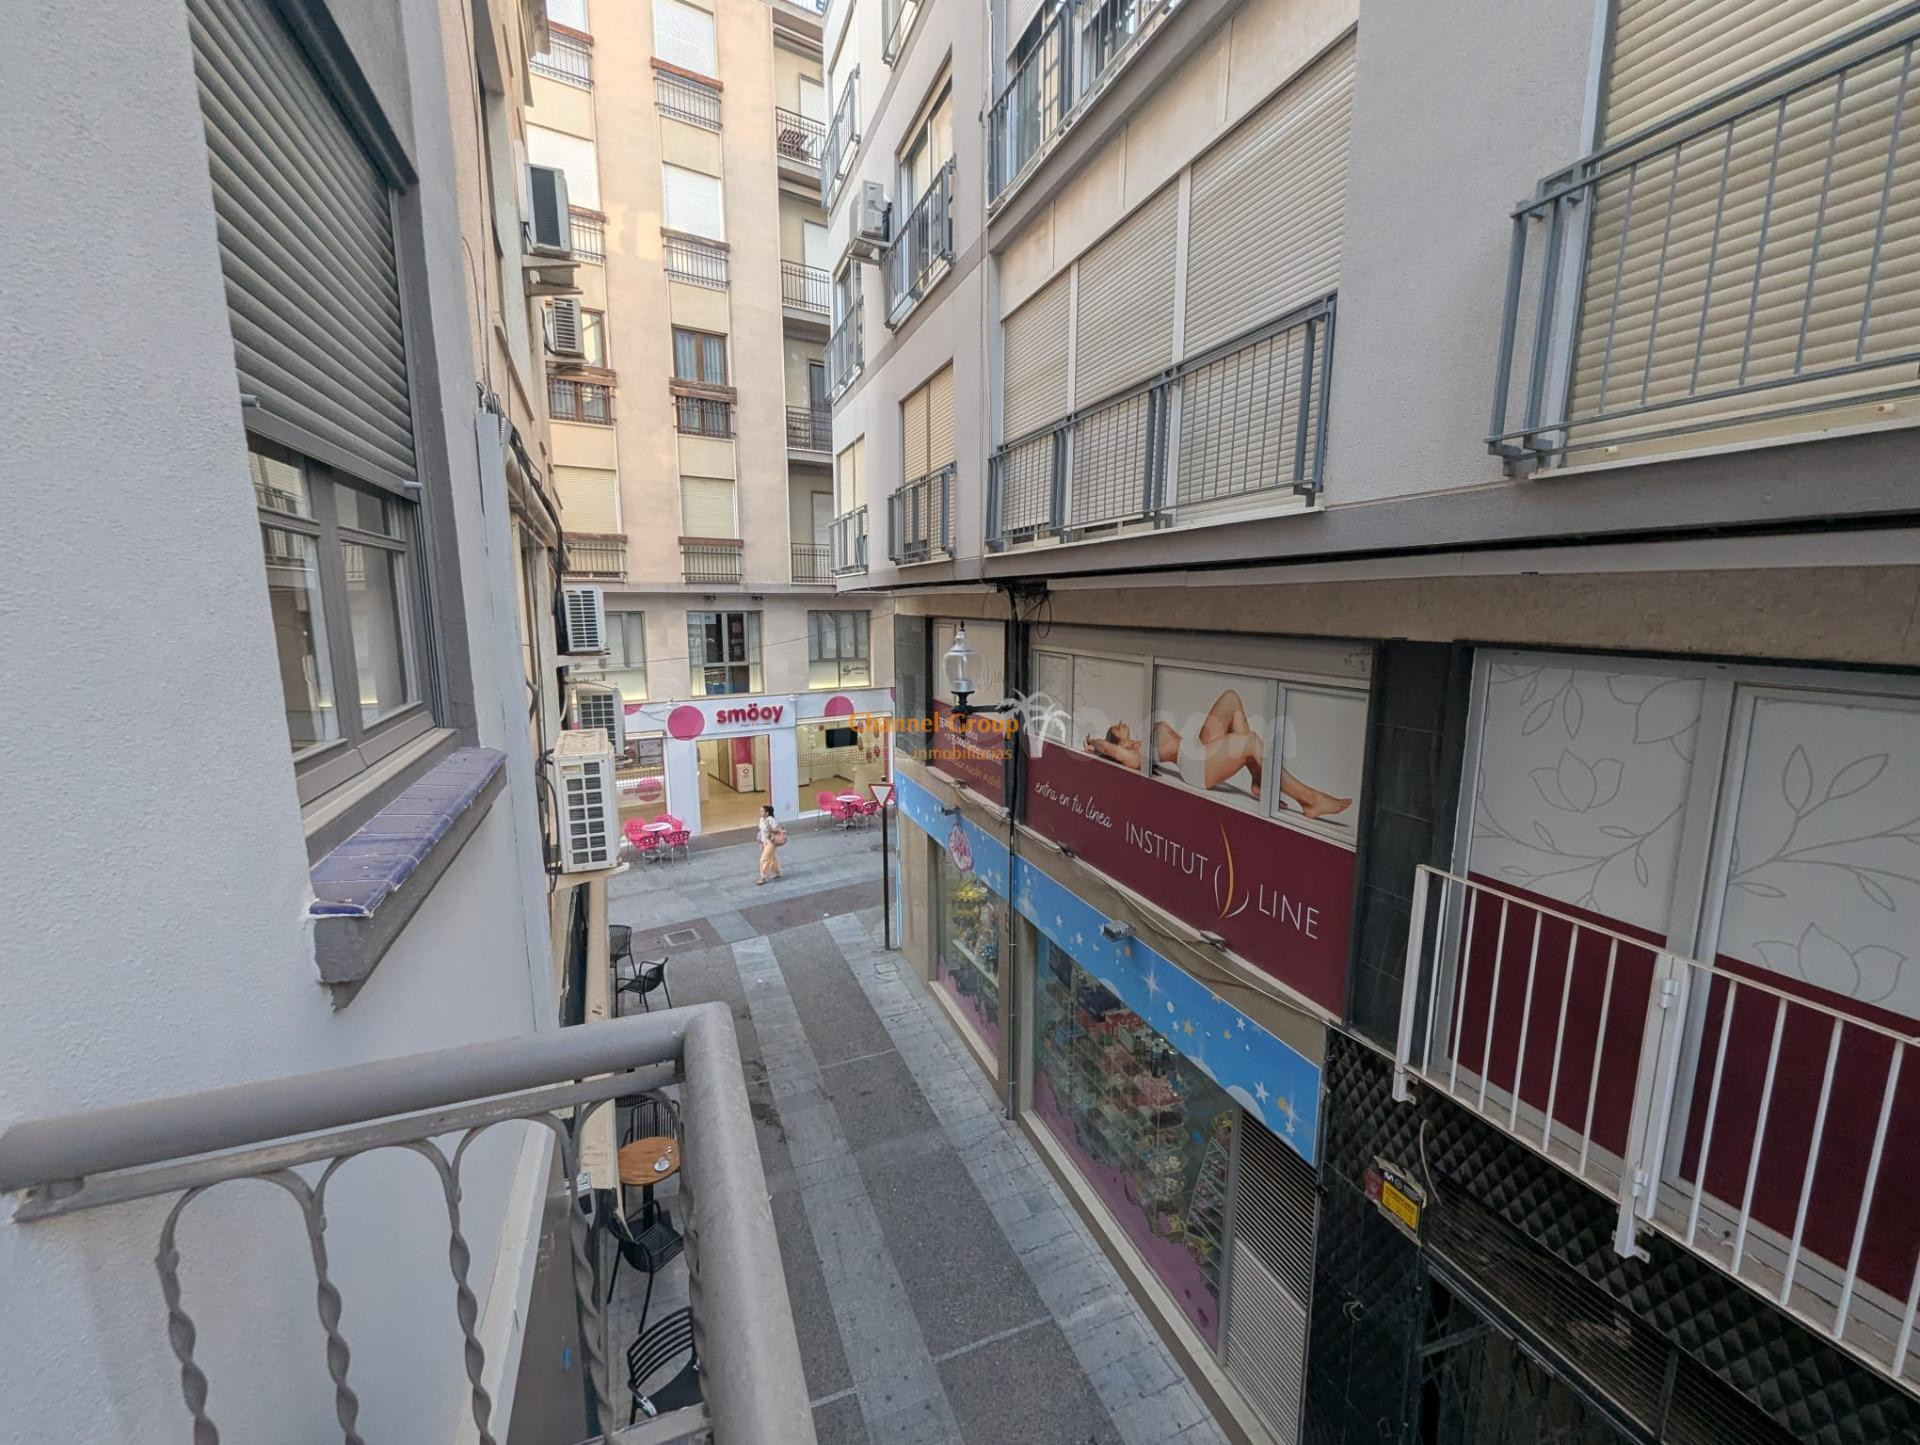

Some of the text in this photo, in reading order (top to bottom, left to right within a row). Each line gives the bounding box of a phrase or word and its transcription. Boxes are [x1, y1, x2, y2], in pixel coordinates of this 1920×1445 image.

[716, 702, 784, 725] smöoy
[1035, 781, 1058, 801] entra
[1059, 793, 1070, 806] en
[1071, 793, 1084, 814] tu
[1125, 820, 1320, 940] INSTITUT LINE
